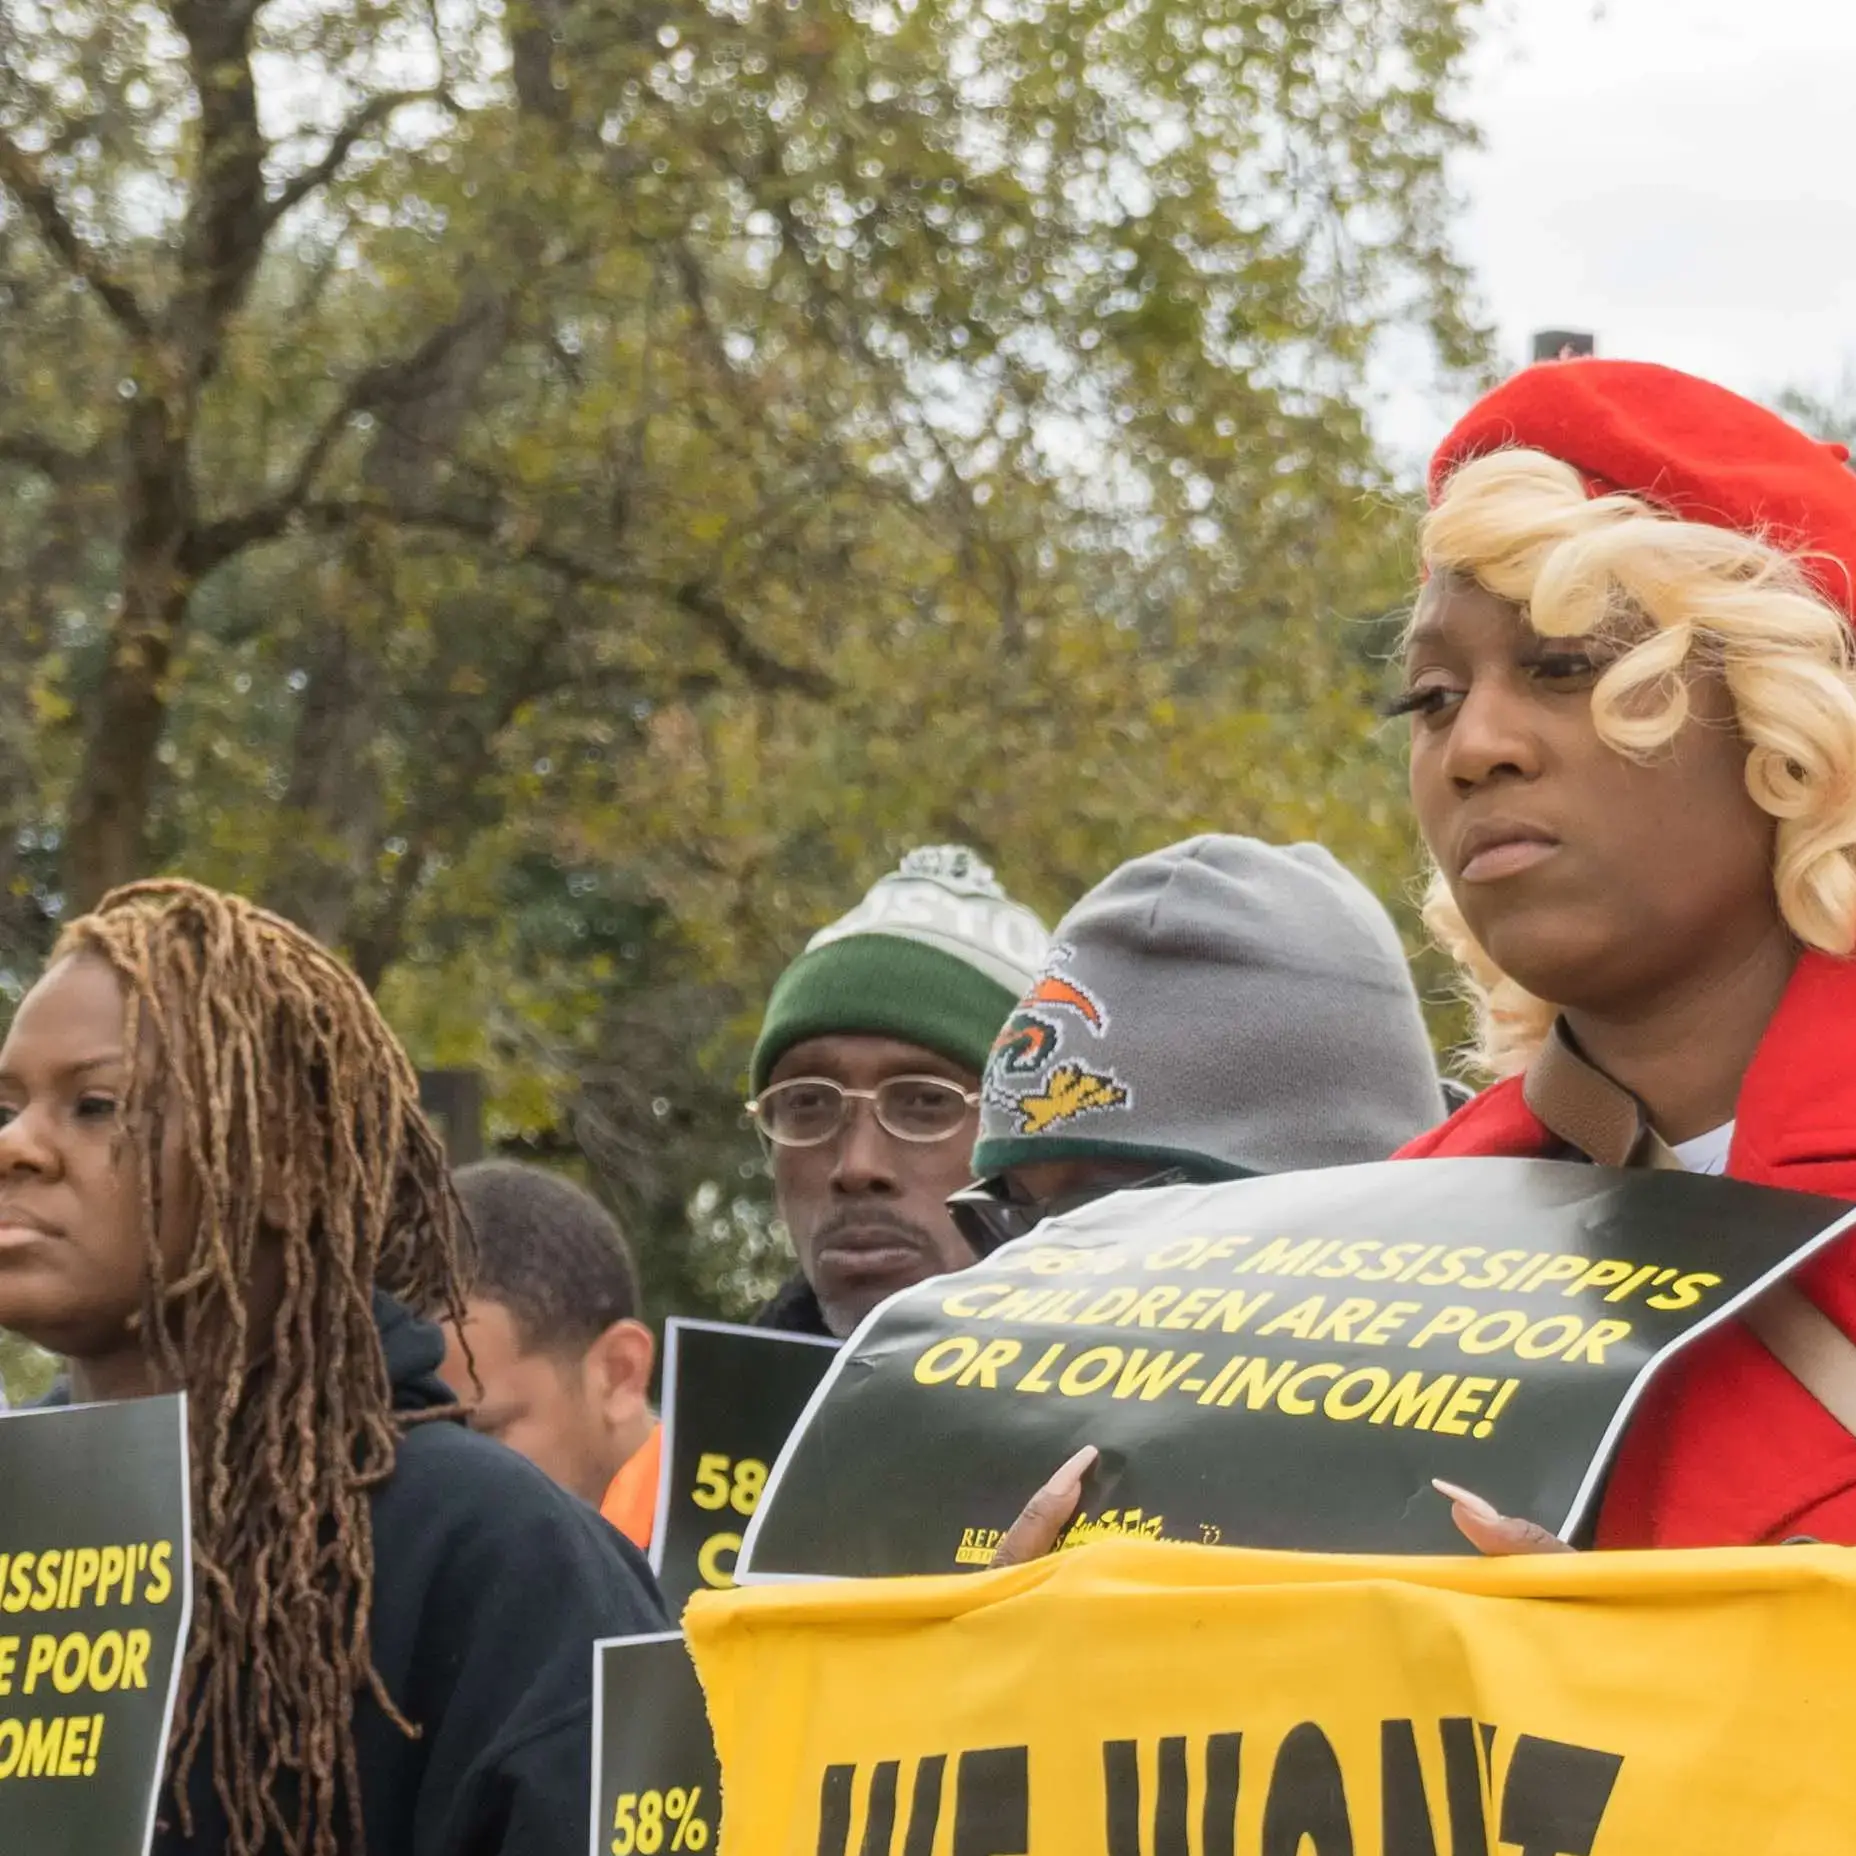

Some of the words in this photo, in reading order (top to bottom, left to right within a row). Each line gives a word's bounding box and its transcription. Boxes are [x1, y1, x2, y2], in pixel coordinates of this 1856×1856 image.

[1144, 1235, 1253, 1272] OF
[1233, 1236, 1722, 1310] MISSISSIPPI'S
[942, 1283, 1275, 1334] CHILDREN
[1254, 1294, 1424, 1346] ARE
[1407, 1304, 1632, 1365] POOR
[914, 1336, 1022, 1389] OR
[1016, 1342, 1520, 1440] LOW-INCOME!
[23, 1628, 151, 1694] POOR
